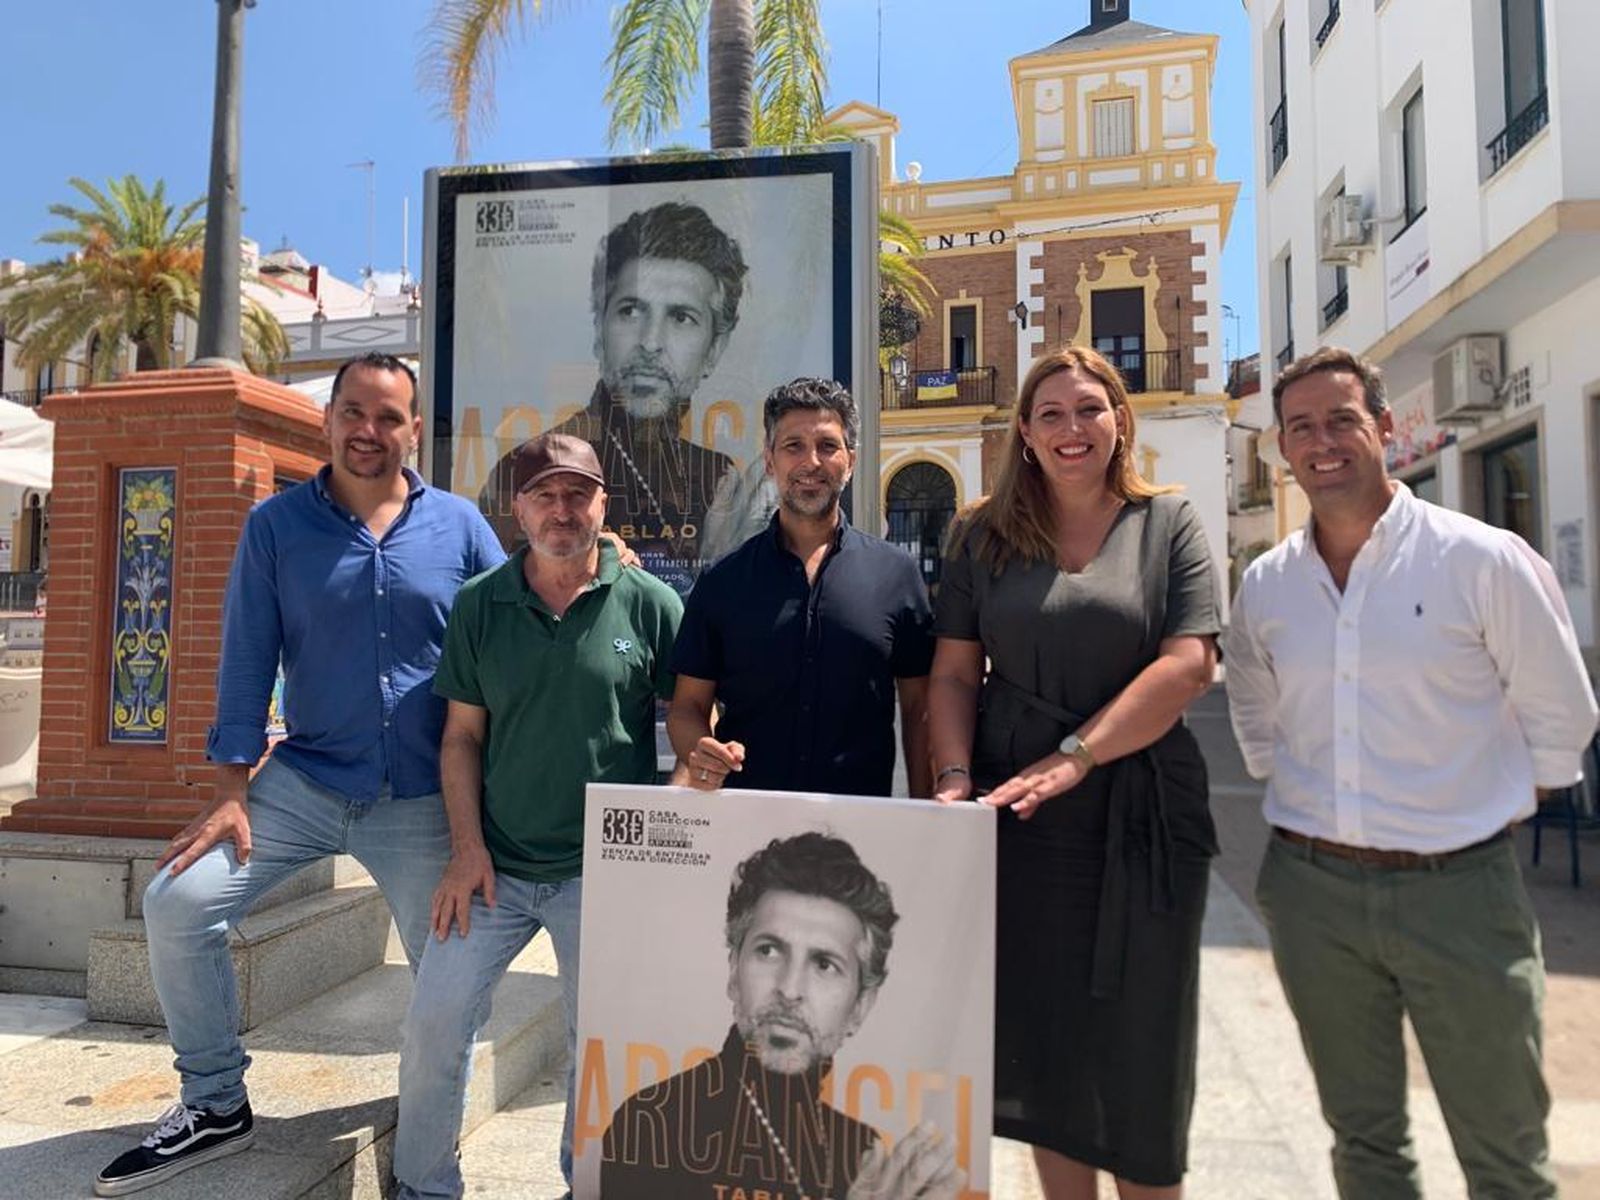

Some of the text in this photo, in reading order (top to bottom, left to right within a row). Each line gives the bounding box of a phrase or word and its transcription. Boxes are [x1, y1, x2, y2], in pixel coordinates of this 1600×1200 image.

[927, 376, 947, 387] PAZ
[603, 808, 644, 845] 33€
[602, 848, 634, 857] VENTA
[619, 854, 646, 862] CASA
